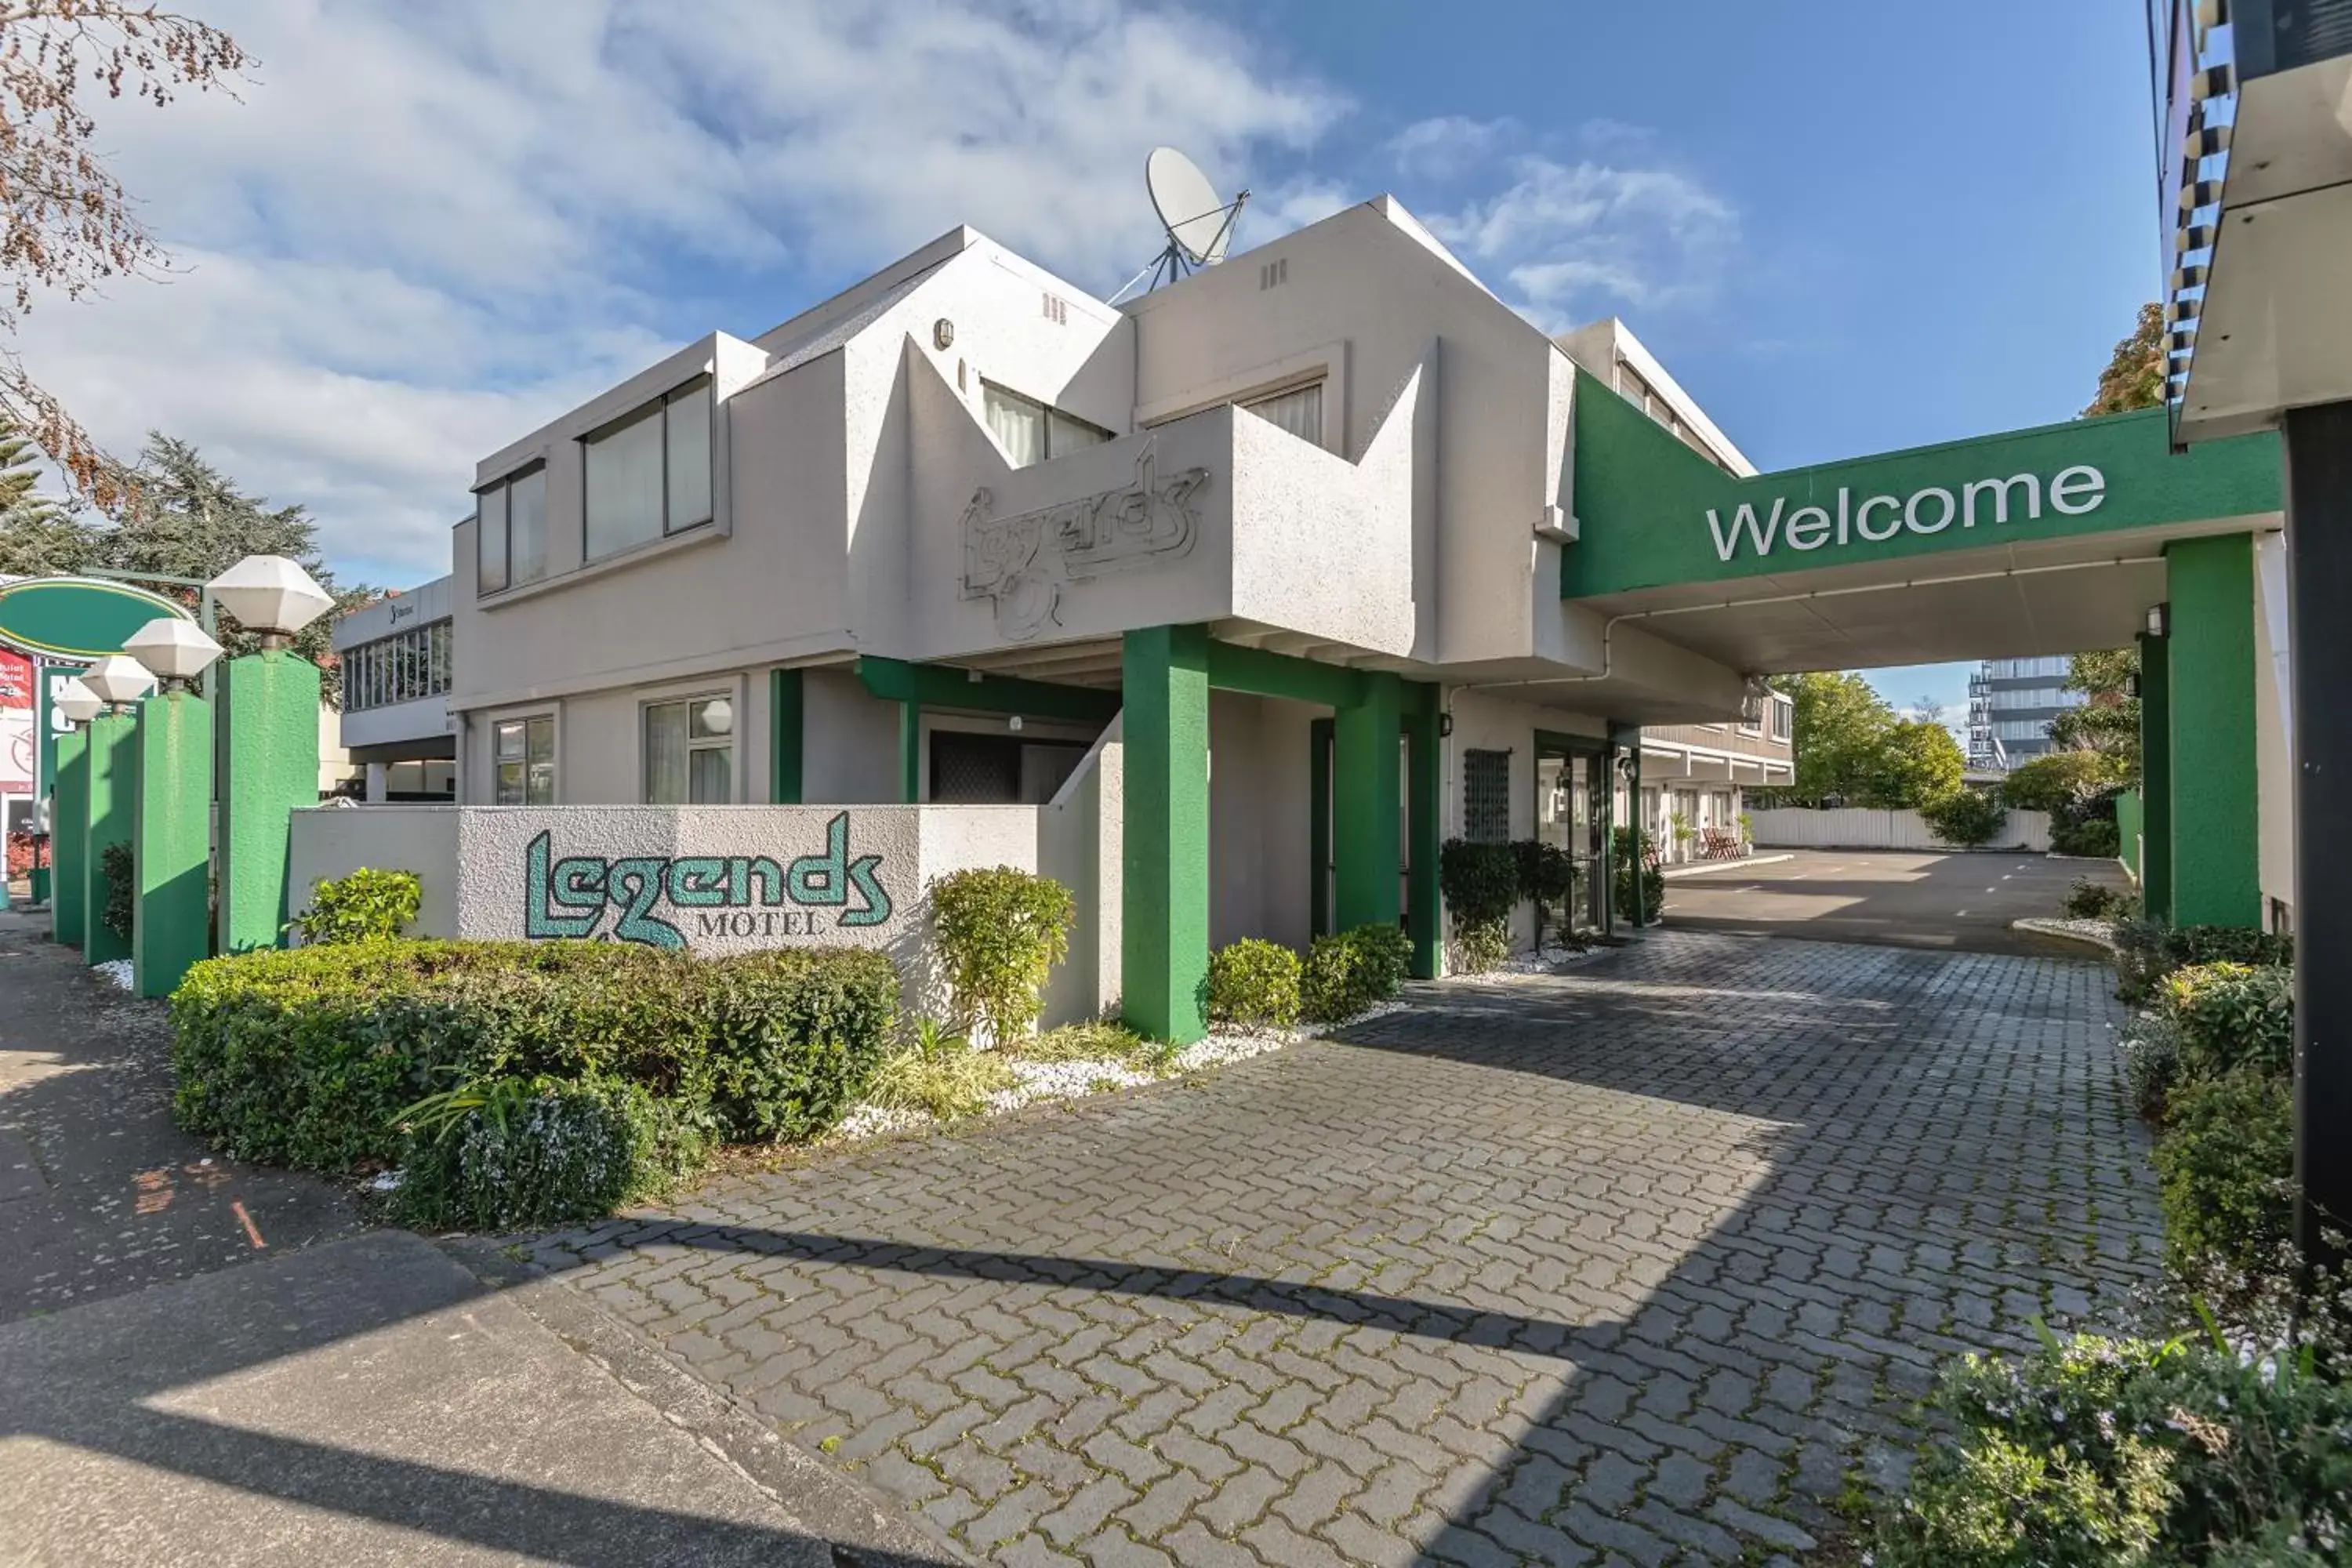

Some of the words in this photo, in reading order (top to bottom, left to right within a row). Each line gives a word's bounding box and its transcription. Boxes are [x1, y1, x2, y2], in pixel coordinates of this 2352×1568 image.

[1706, 465, 2105, 561] Welcome
[525, 810, 892, 949] Legends
[697, 910, 826, 938] MOTEL
